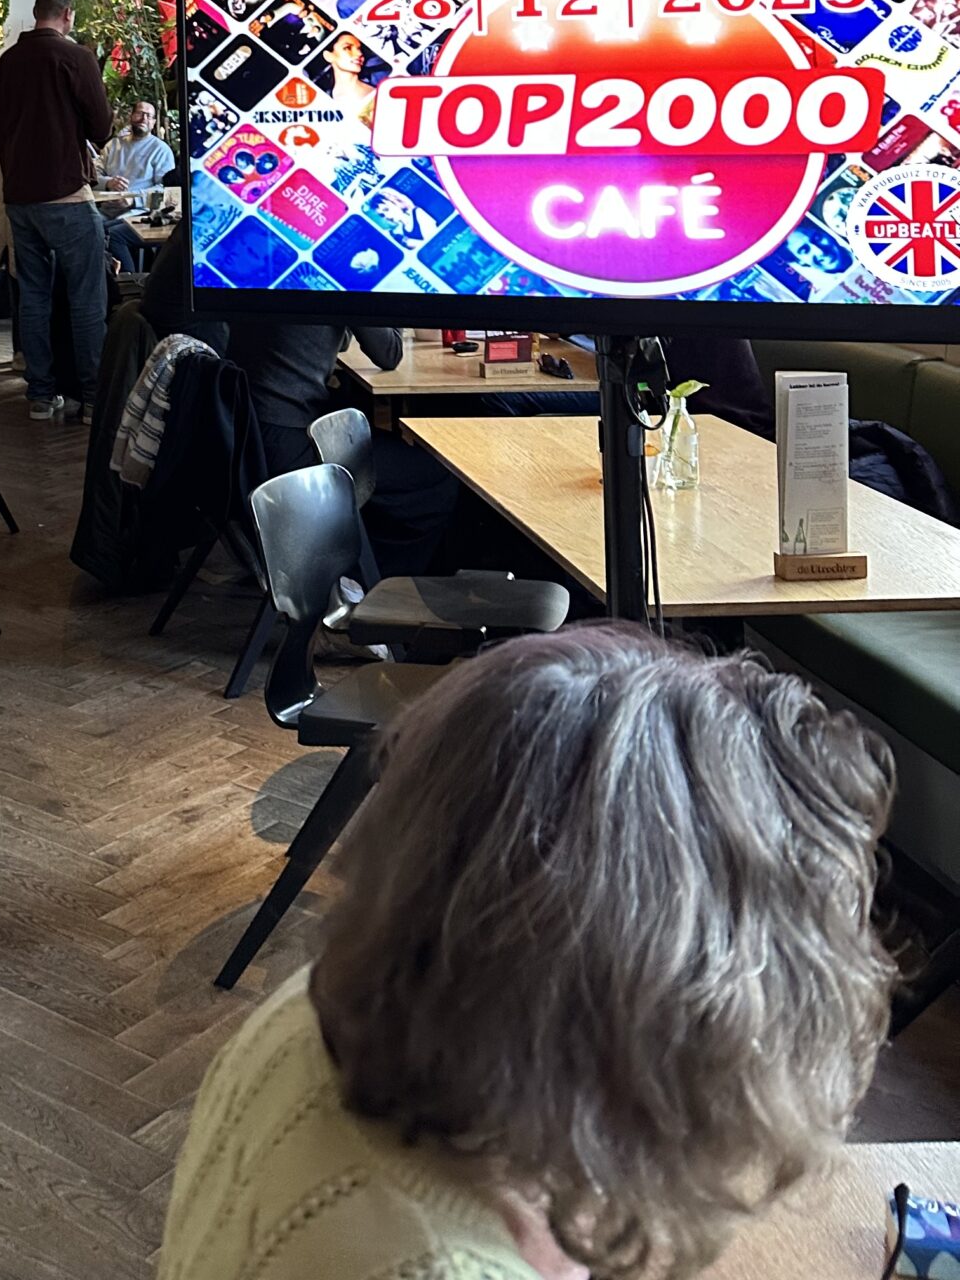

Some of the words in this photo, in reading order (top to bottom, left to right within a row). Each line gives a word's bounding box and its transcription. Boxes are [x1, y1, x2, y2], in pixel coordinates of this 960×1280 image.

[854, 53, 902, 68] GOLDEN
[296, 184, 329, 213] DIRE
[857, 191, 873, 208] VAN
[873, 170, 920, 191] PUBQUIZ
[926, 169, 946, 180] TOT
[281, 186, 327, 227] STRAITS
[532, 173, 726, 241] CAFÉ
[901, 276, 928, 288] SINCE
